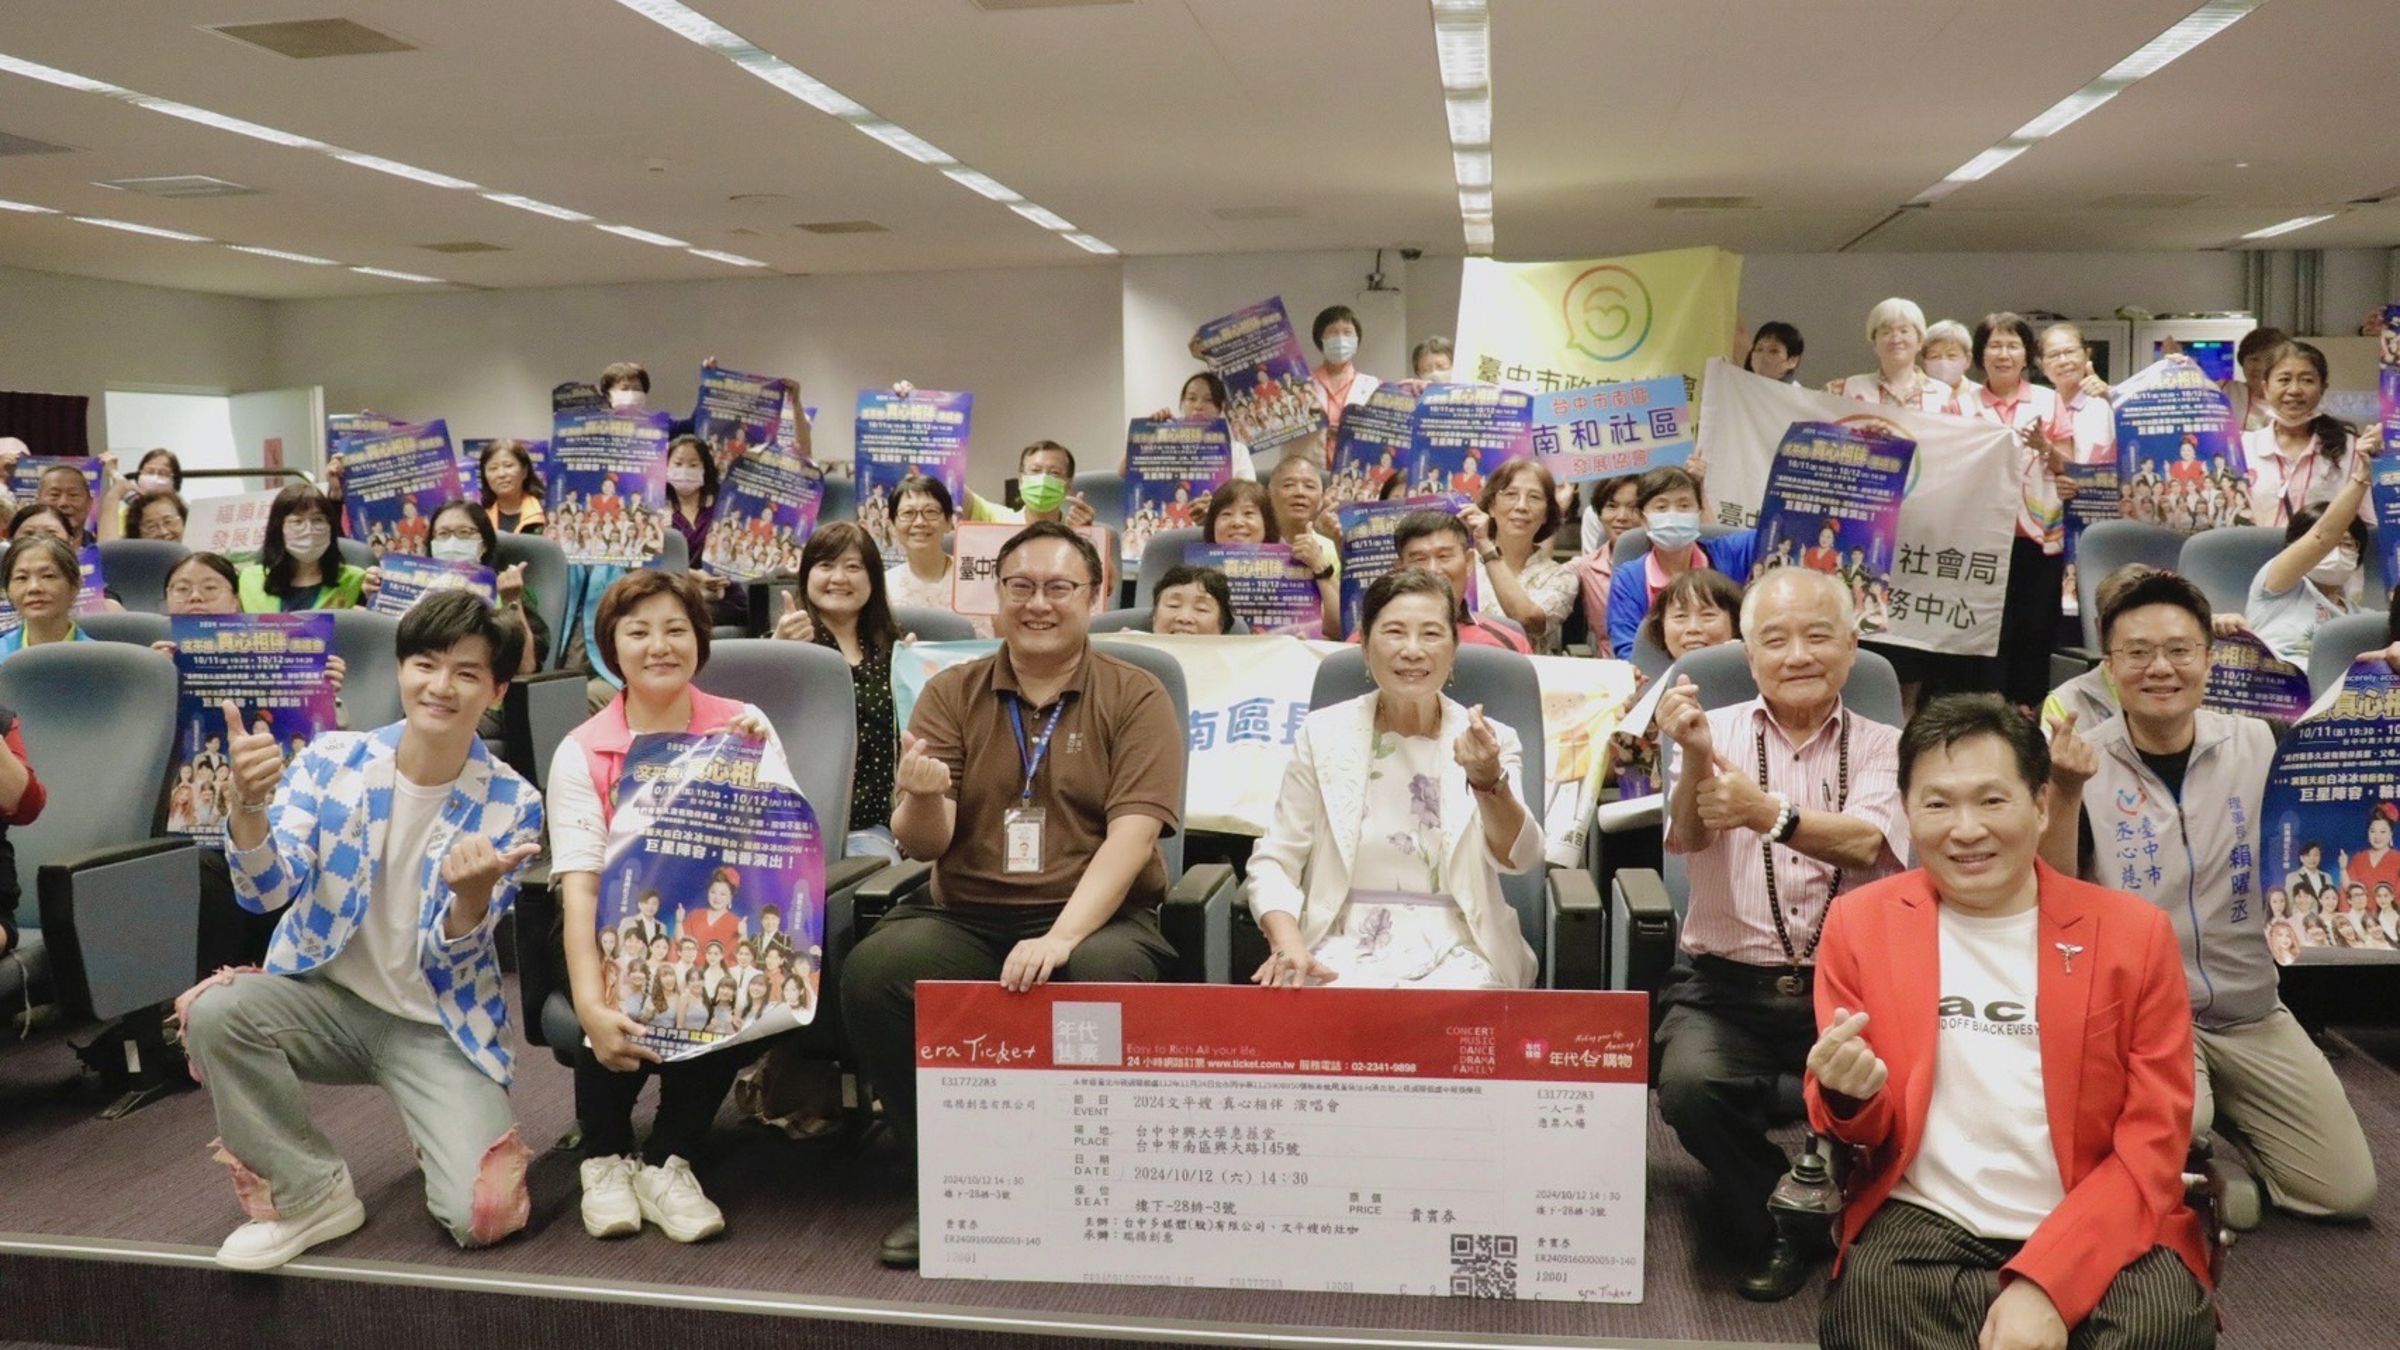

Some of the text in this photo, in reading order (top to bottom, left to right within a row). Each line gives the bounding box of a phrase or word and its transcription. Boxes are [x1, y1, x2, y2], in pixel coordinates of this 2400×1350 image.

[1531, 407, 1680, 457] 南和社區
[1898, 542, 1999, 585] 社會局
[2349, 727, 2375, 736] 19:30
[2138, 815, 2163, 888] 臺中市
[1056, 1020, 1099, 1041] 年代
[1949, 1017, 1970, 1031] OFF
[921, 1033, 1037, 1064] era Ticket
[1127, 1056, 1140, 1067] 24
[1207, 1059, 1296, 1070] www.ticket.com.tw
[1074, 1107, 1109, 1116] EVENT
[1223, 1096, 1284, 1111] 真心相伴
[1294, 1098, 1340, 1113] 演唱會
[1074, 1137, 1109, 1146] PLACE
[1074, 1167, 1109, 1176] DATE
[1134, 1167, 1214, 1183] 2024/10/12
[1074, 1197, 1110, 1206] SEAT
[1349, 1206, 1383, 1215] PRICE
